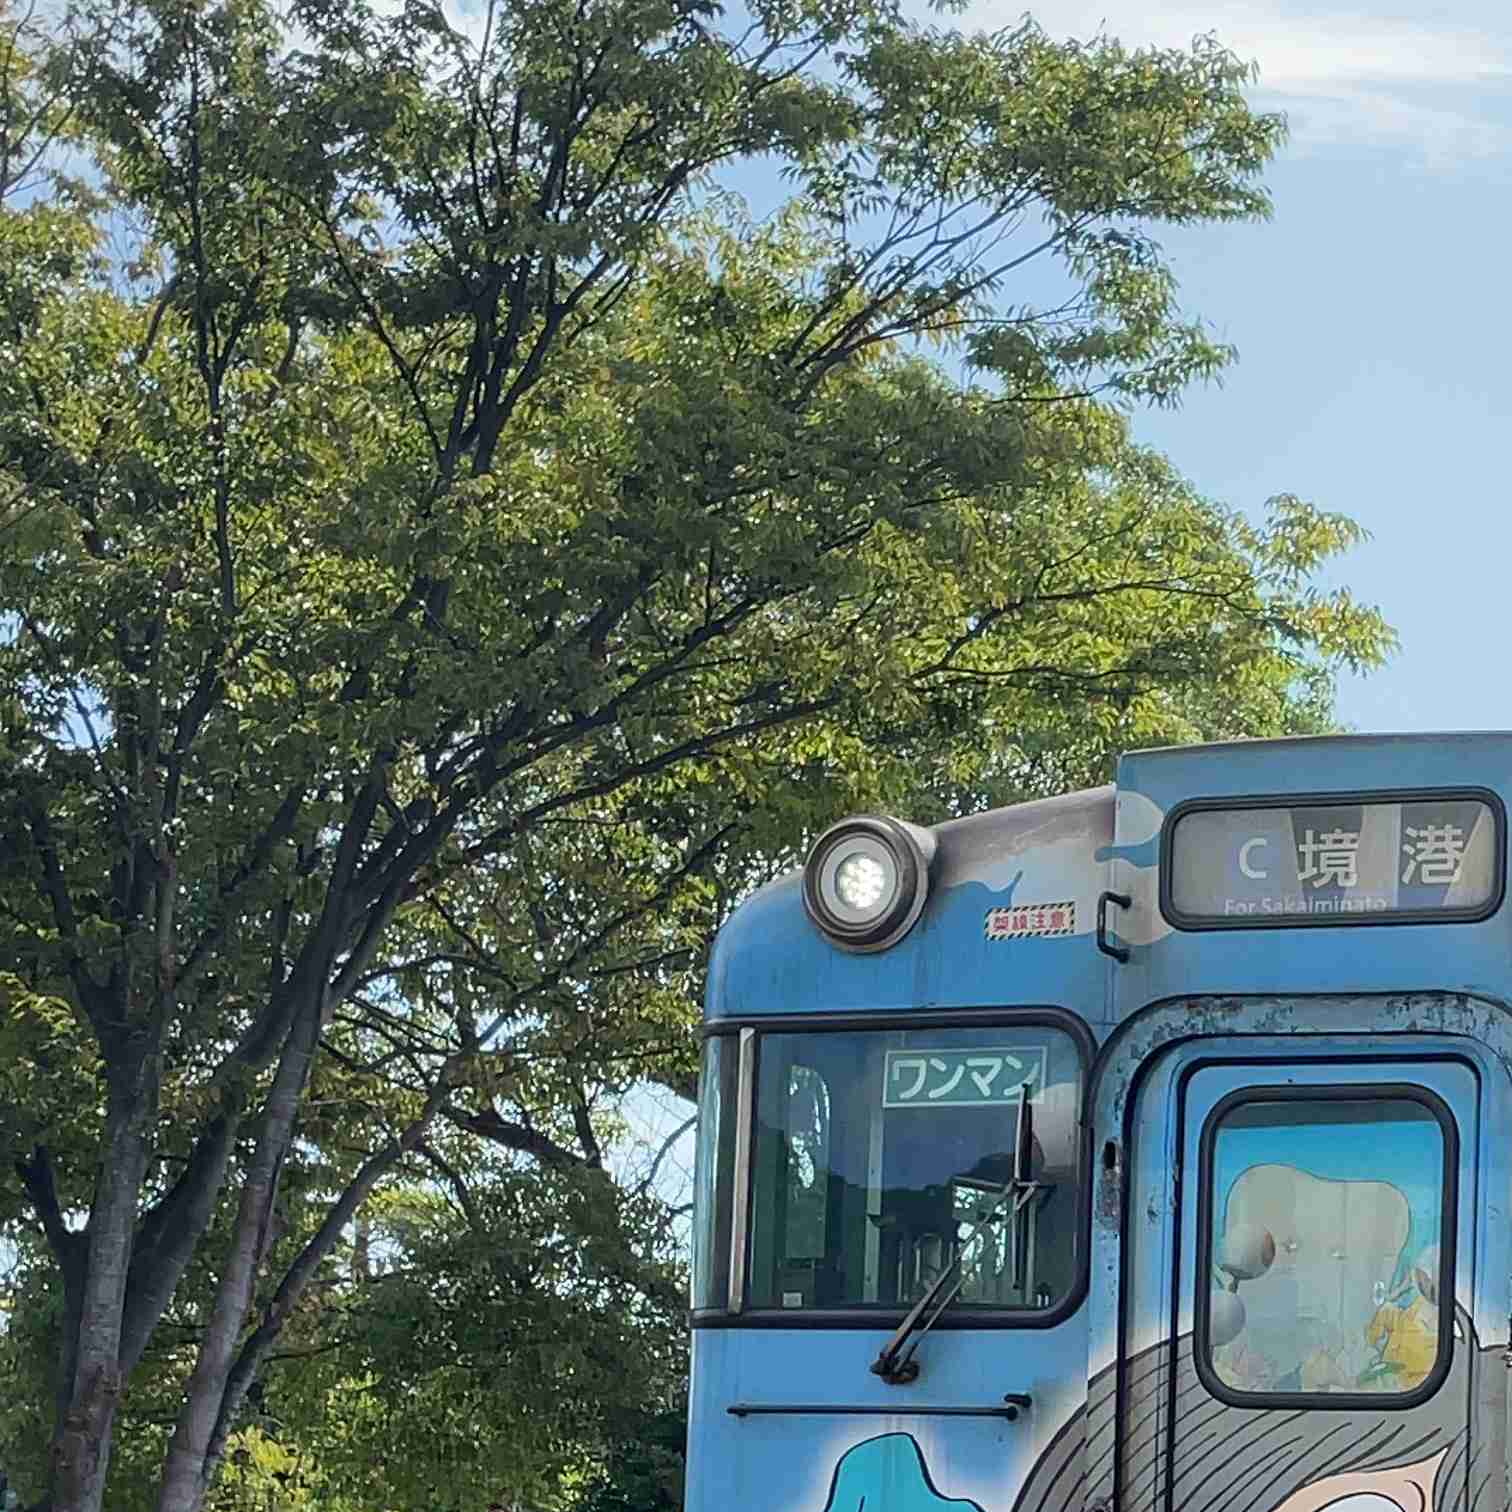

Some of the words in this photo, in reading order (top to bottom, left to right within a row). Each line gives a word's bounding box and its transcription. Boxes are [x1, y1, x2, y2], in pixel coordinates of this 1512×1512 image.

[1238, 837, 1268, 880] C
[1296, 823, 1465, 888] 境港
[1224, 898, 1257, 916] For
[1261, 895, 1388, 915] Sakaiminato
[892, 1054, 1041, 1100] ワンマン
